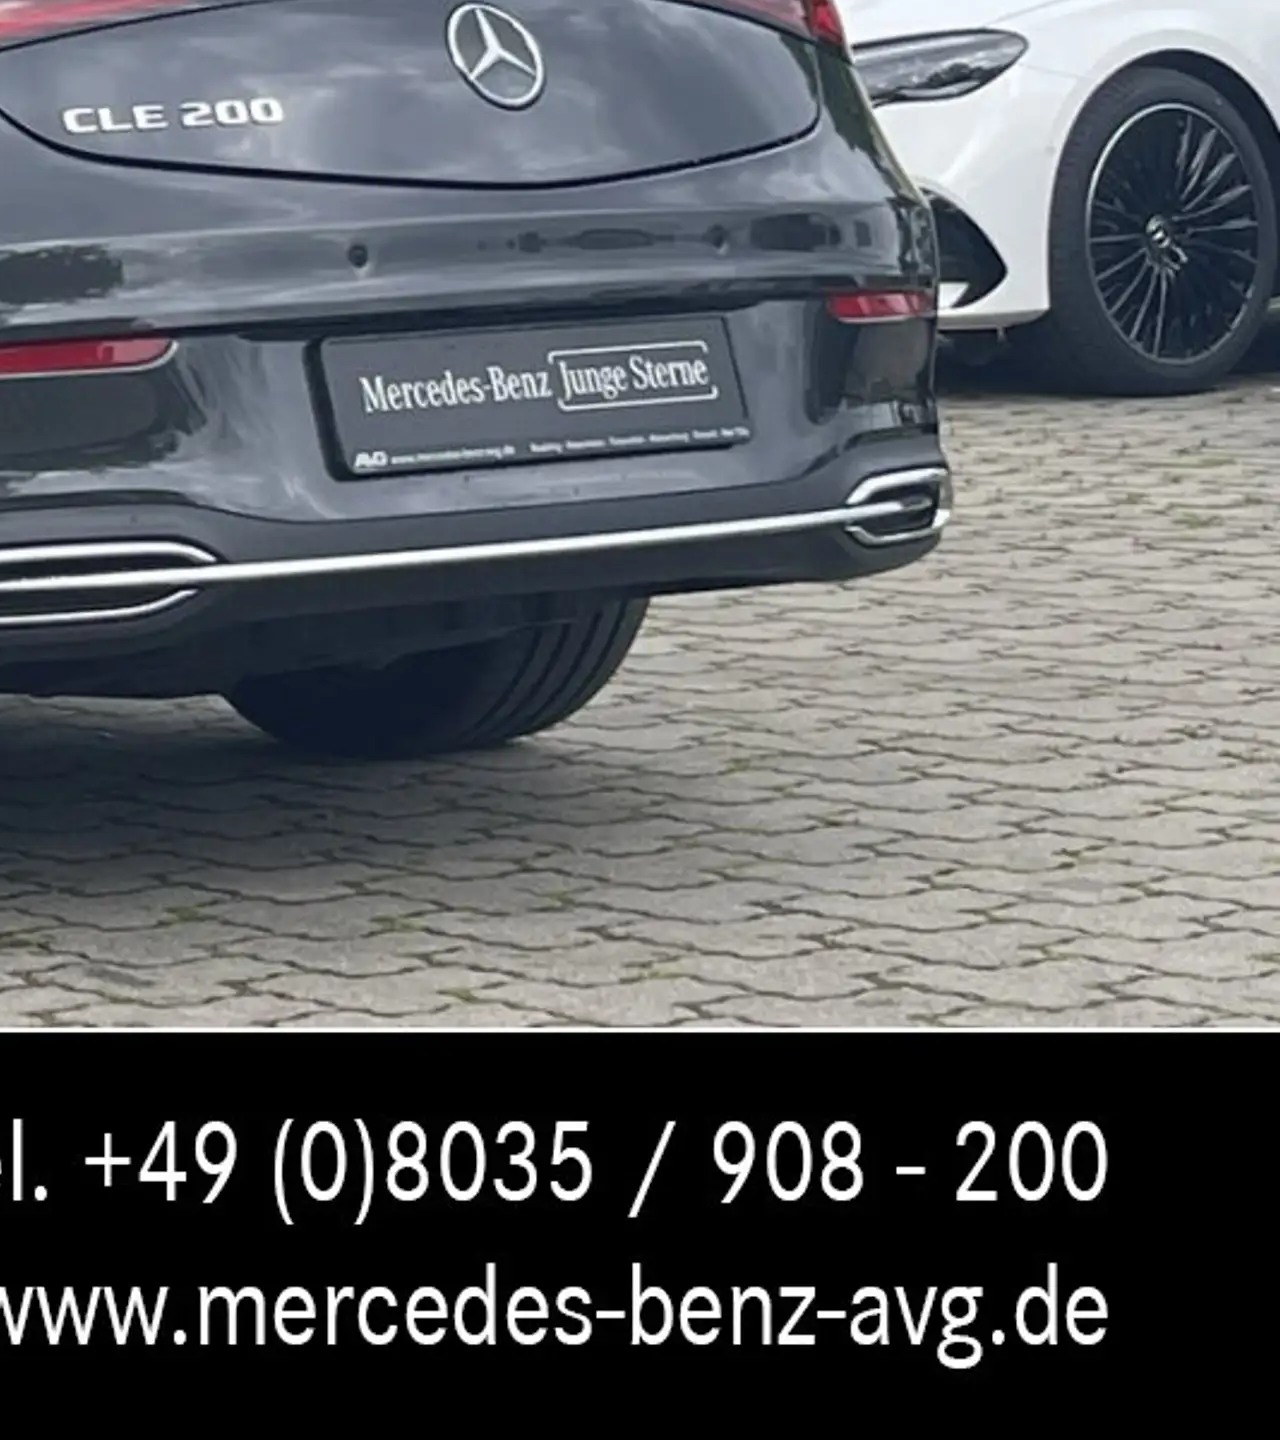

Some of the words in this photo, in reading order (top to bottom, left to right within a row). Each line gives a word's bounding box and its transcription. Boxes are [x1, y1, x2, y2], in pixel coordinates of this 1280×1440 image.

[61, 104, 170, 134] CLE
[178, 96, 285, 127] 200
[359, 365, 553, 413] Mercedes-Benz
[559, 360, 629, 400] Junge
[628, 354, 709, 390] Sterne
